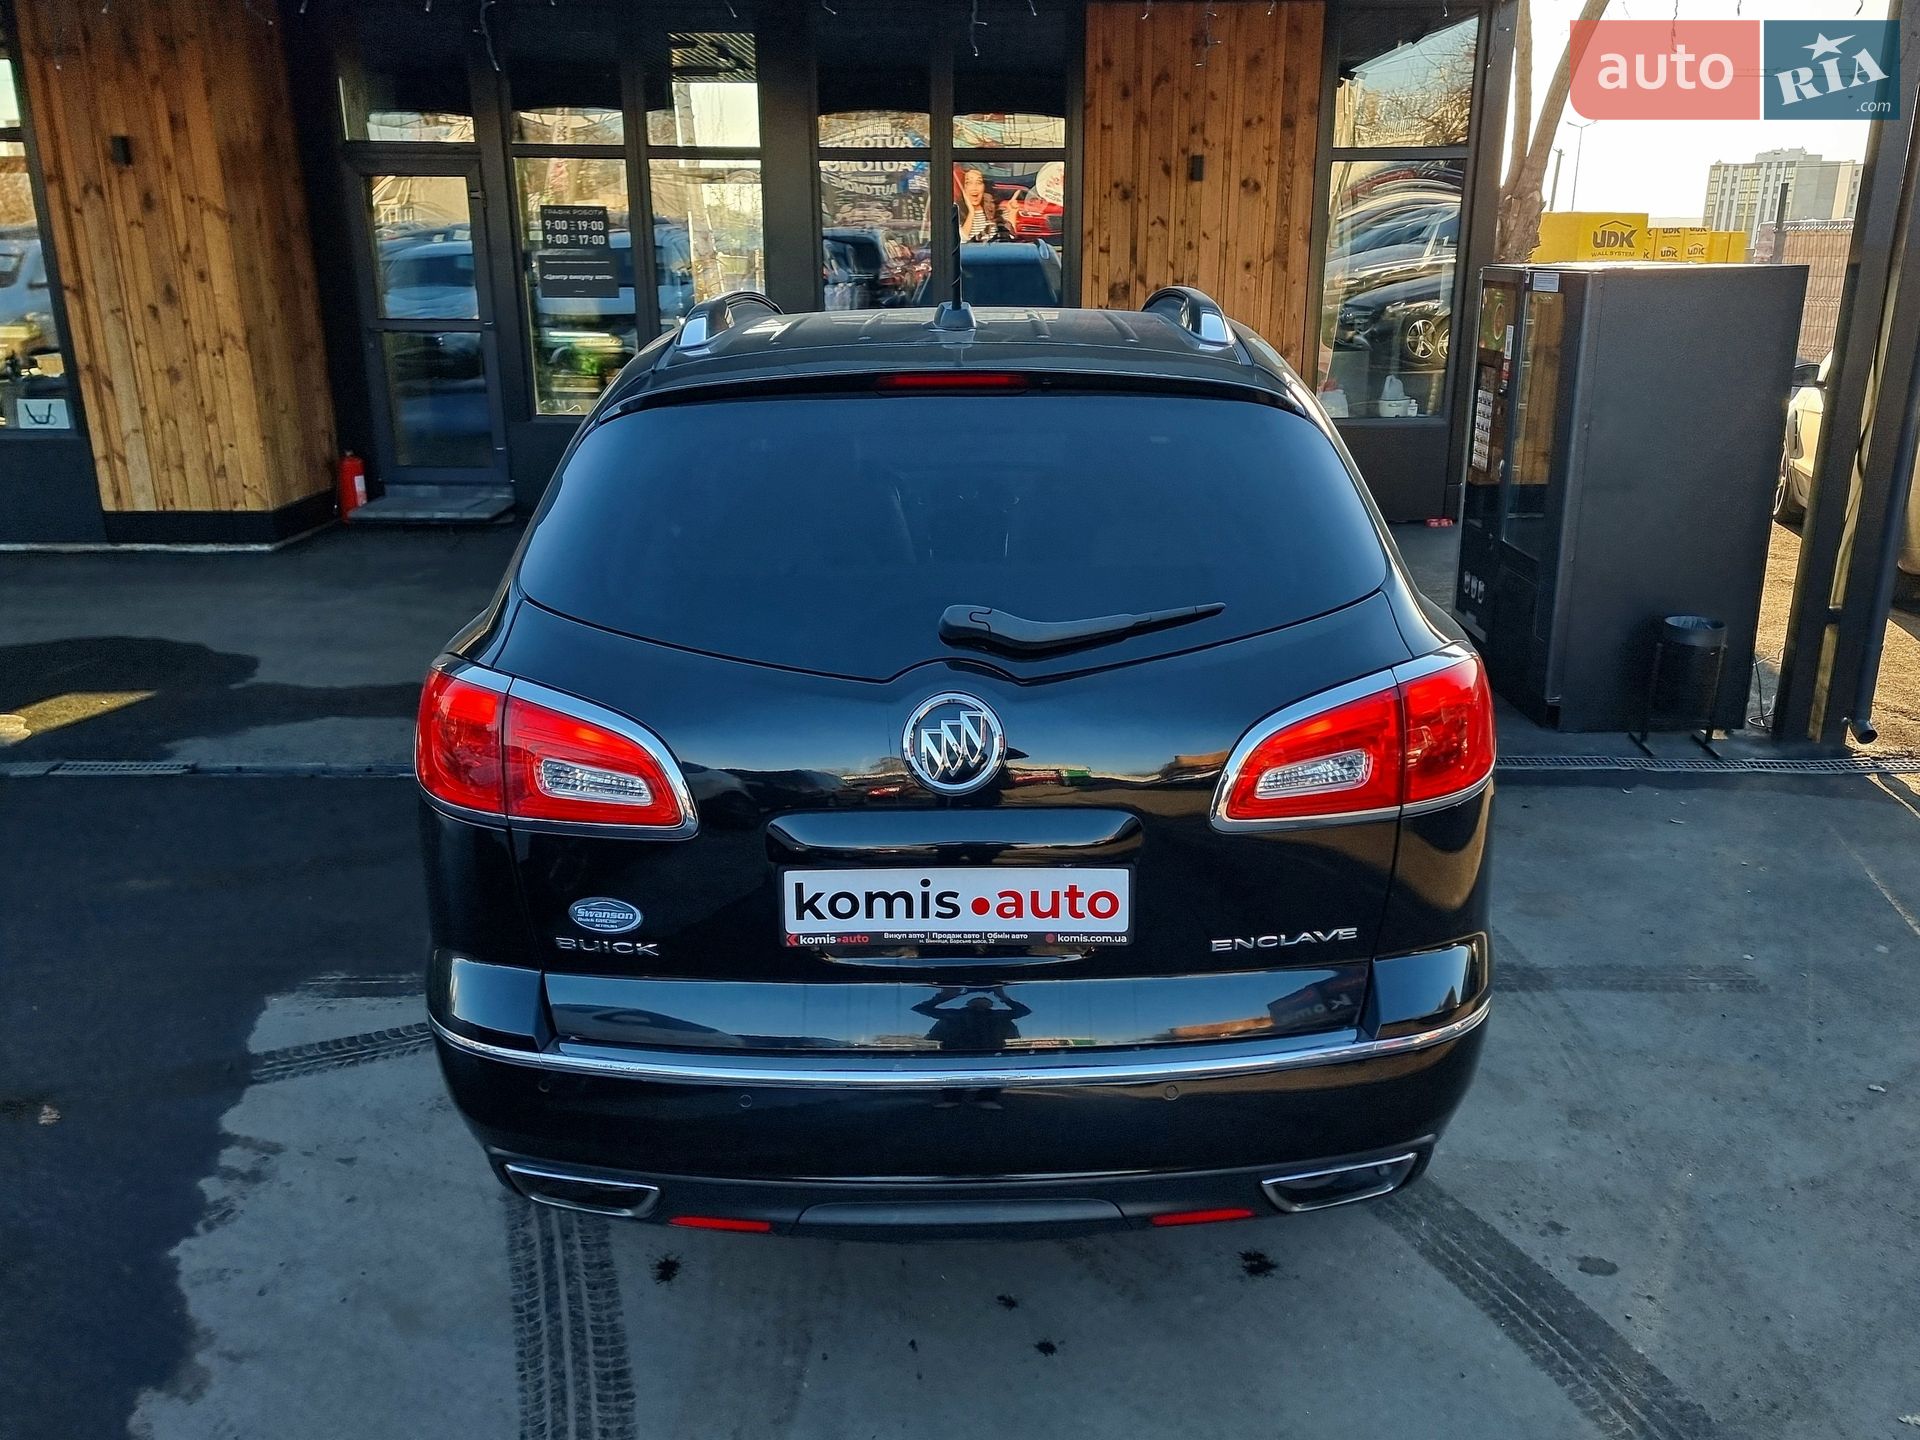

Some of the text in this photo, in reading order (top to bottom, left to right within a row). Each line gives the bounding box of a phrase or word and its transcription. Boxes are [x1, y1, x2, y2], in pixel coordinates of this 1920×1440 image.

[545, 220, 568, 231] 9:00
[577, 220, 605, 231] 19:00
[546, 234, 569, 245] 9:00
[578, 234, 605, 246] 17:00
[1592, 229, 1638, 249] UDK
[1660, 249, 1678, 258] UDK
[1687, 247, 1705, 256] UDK
[794, 878, 961, 920] komis
[576, 907, 634, 920] Swanson
[883, 932, 907, 940] Викуп
[932, 932, 963, 940] Продаж
[1057, 933, 1128, 944] komis.com.ua
[1211, 927, 1358, 952] ENCLAVE
[555, 937, 660, 956] BUICK
